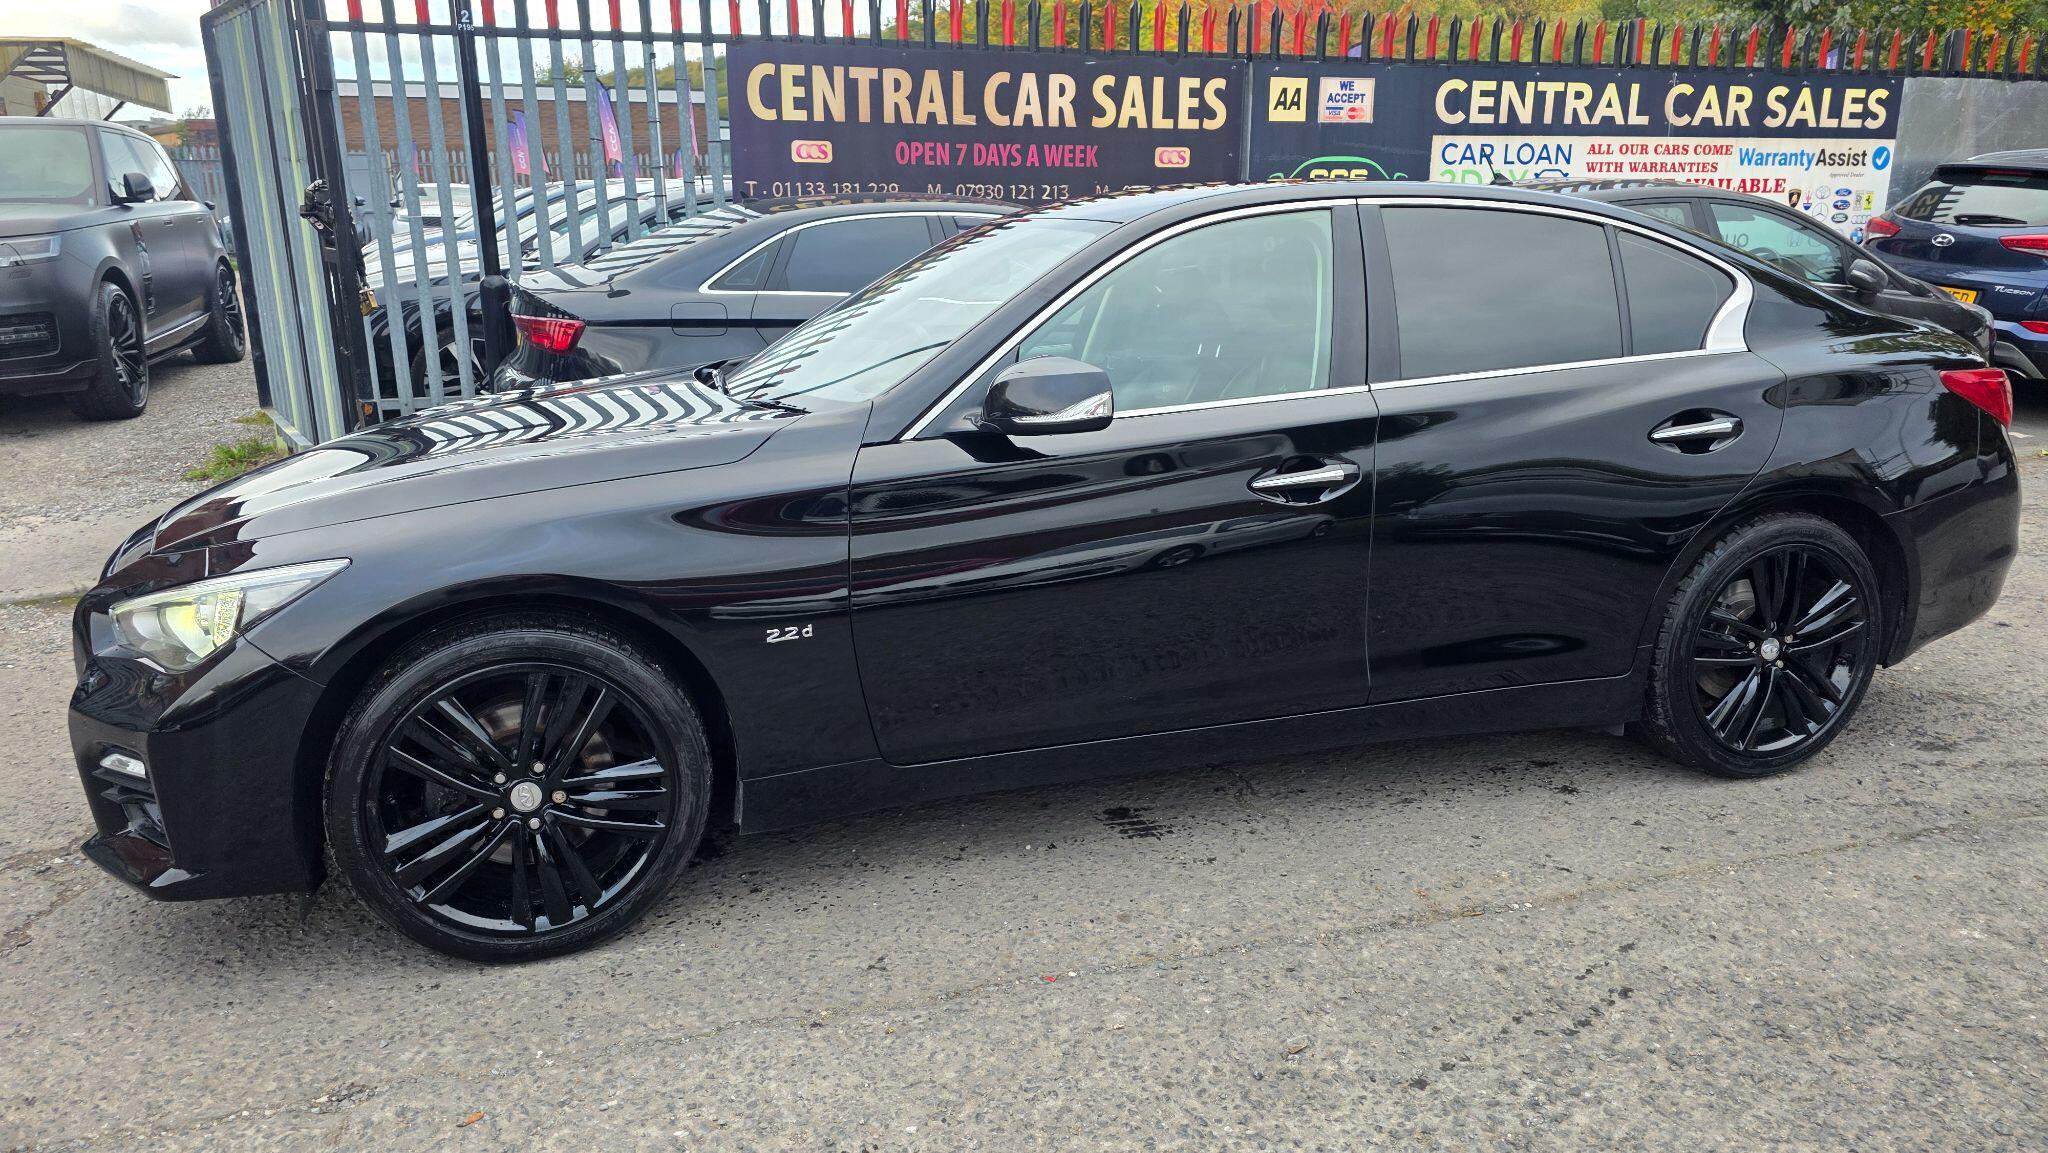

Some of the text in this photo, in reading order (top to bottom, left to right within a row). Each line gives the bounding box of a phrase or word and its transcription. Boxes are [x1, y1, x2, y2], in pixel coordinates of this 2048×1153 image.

[460, 9, 470, 23] 2
[1339, 80, 1355, 91] WE
[746, 62, 1228, 131] CENTRAL CAR SALES
[1273, 87, 1301, 111] AA
[1327, 93, 1366, 104] ACCEPT
[1435, 78, 1890, 130] CENTRAL CAR SALES
[895, 141, 1099, 168] OPEN 7 DAYS A WEEK
[1441, 143, 1573, 165] CAR LOAN
[1587, 144, 1734, 156] ALL OUR CARS COME
[1586, 161, 1719, 173] WITH WARRANTIES
[772, 181, 826, 198] 01133
[832, 182, 860, 194] 181
[956, 184, 1004, 199] 07930
[1009, 184, 1034, 199] 121
[1041, 184, 1069, 199] 213
[1685, 178, 1787, 194] AILABLE
